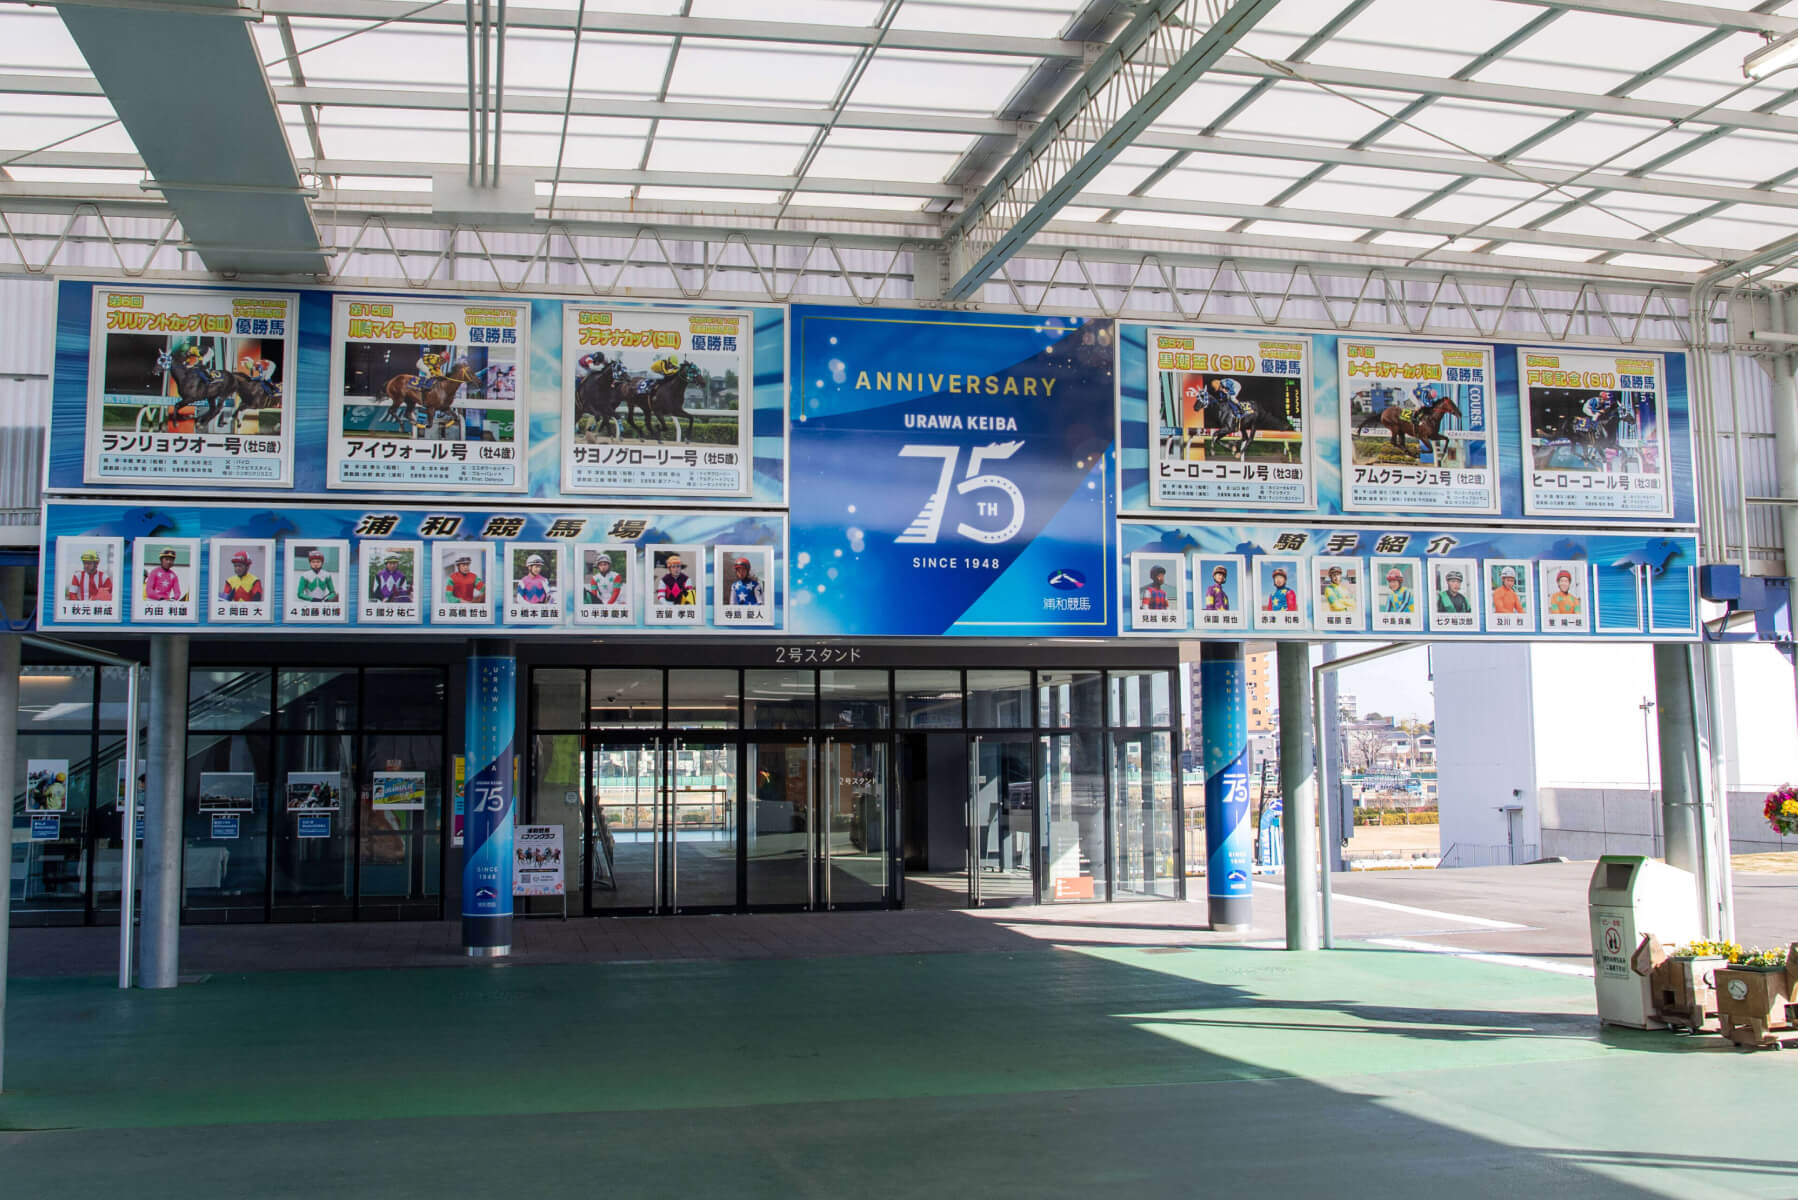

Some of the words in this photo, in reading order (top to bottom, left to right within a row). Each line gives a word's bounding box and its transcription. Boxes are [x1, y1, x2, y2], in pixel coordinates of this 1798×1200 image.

[236, 318, 285, 335] 優勝馬
[469, 327, 517, 343] 優勝馬
[691, 335, 737, 351] 優勝馬
[1261, 359, 1301, 374] 優勝馬
[1446, 367, 1484, 382] 優勝馬
[855, 371, 1057, 397] ANNIVERSARY
[1620, 375, 1655, 389] 優勝馬
[904, 414, 963, 429] URAWA
[968, 415, 1017, 431] KEIBA
[103, 435, 241, 455] ランリョウオー号
[347, 441, 468, 460] アイウォール号
[573, 447, 698, 466] サヨノグローリー号
[1160, 462, 1269, 481] ヒーローコール号
[1354, 468, 1451, 486] アムクラージュ号
[1532, 474, 1630, 490] ヒーローコール号
[894, 440, 1026, 544] 75
[977, 502, 998, 516] TH
[356, 515, 647, 538] 浦和競馬場
[1273, 533, 1457, 554] 騎手紹介
[913, 558, 957, 568] SINCE
[965, 559, 1000, 569] 1948
[72, 607, 91, 615] 秋元
[144, 607, 163, 616] 内田
[1043, 596, 1091, 611] 浦和競馬
[217, 608, 225, 616] 2
[253, 608, 263, 616] 大
[290, 608, 298, 616] 4
[366, 608, 373, 616] 5
[438, 609, 446, 617] 8
[776, 647, 862, 663] 2号スタンド
[473, 787, 504, 812] 75
[1222, 780, 1248, 803] 75
